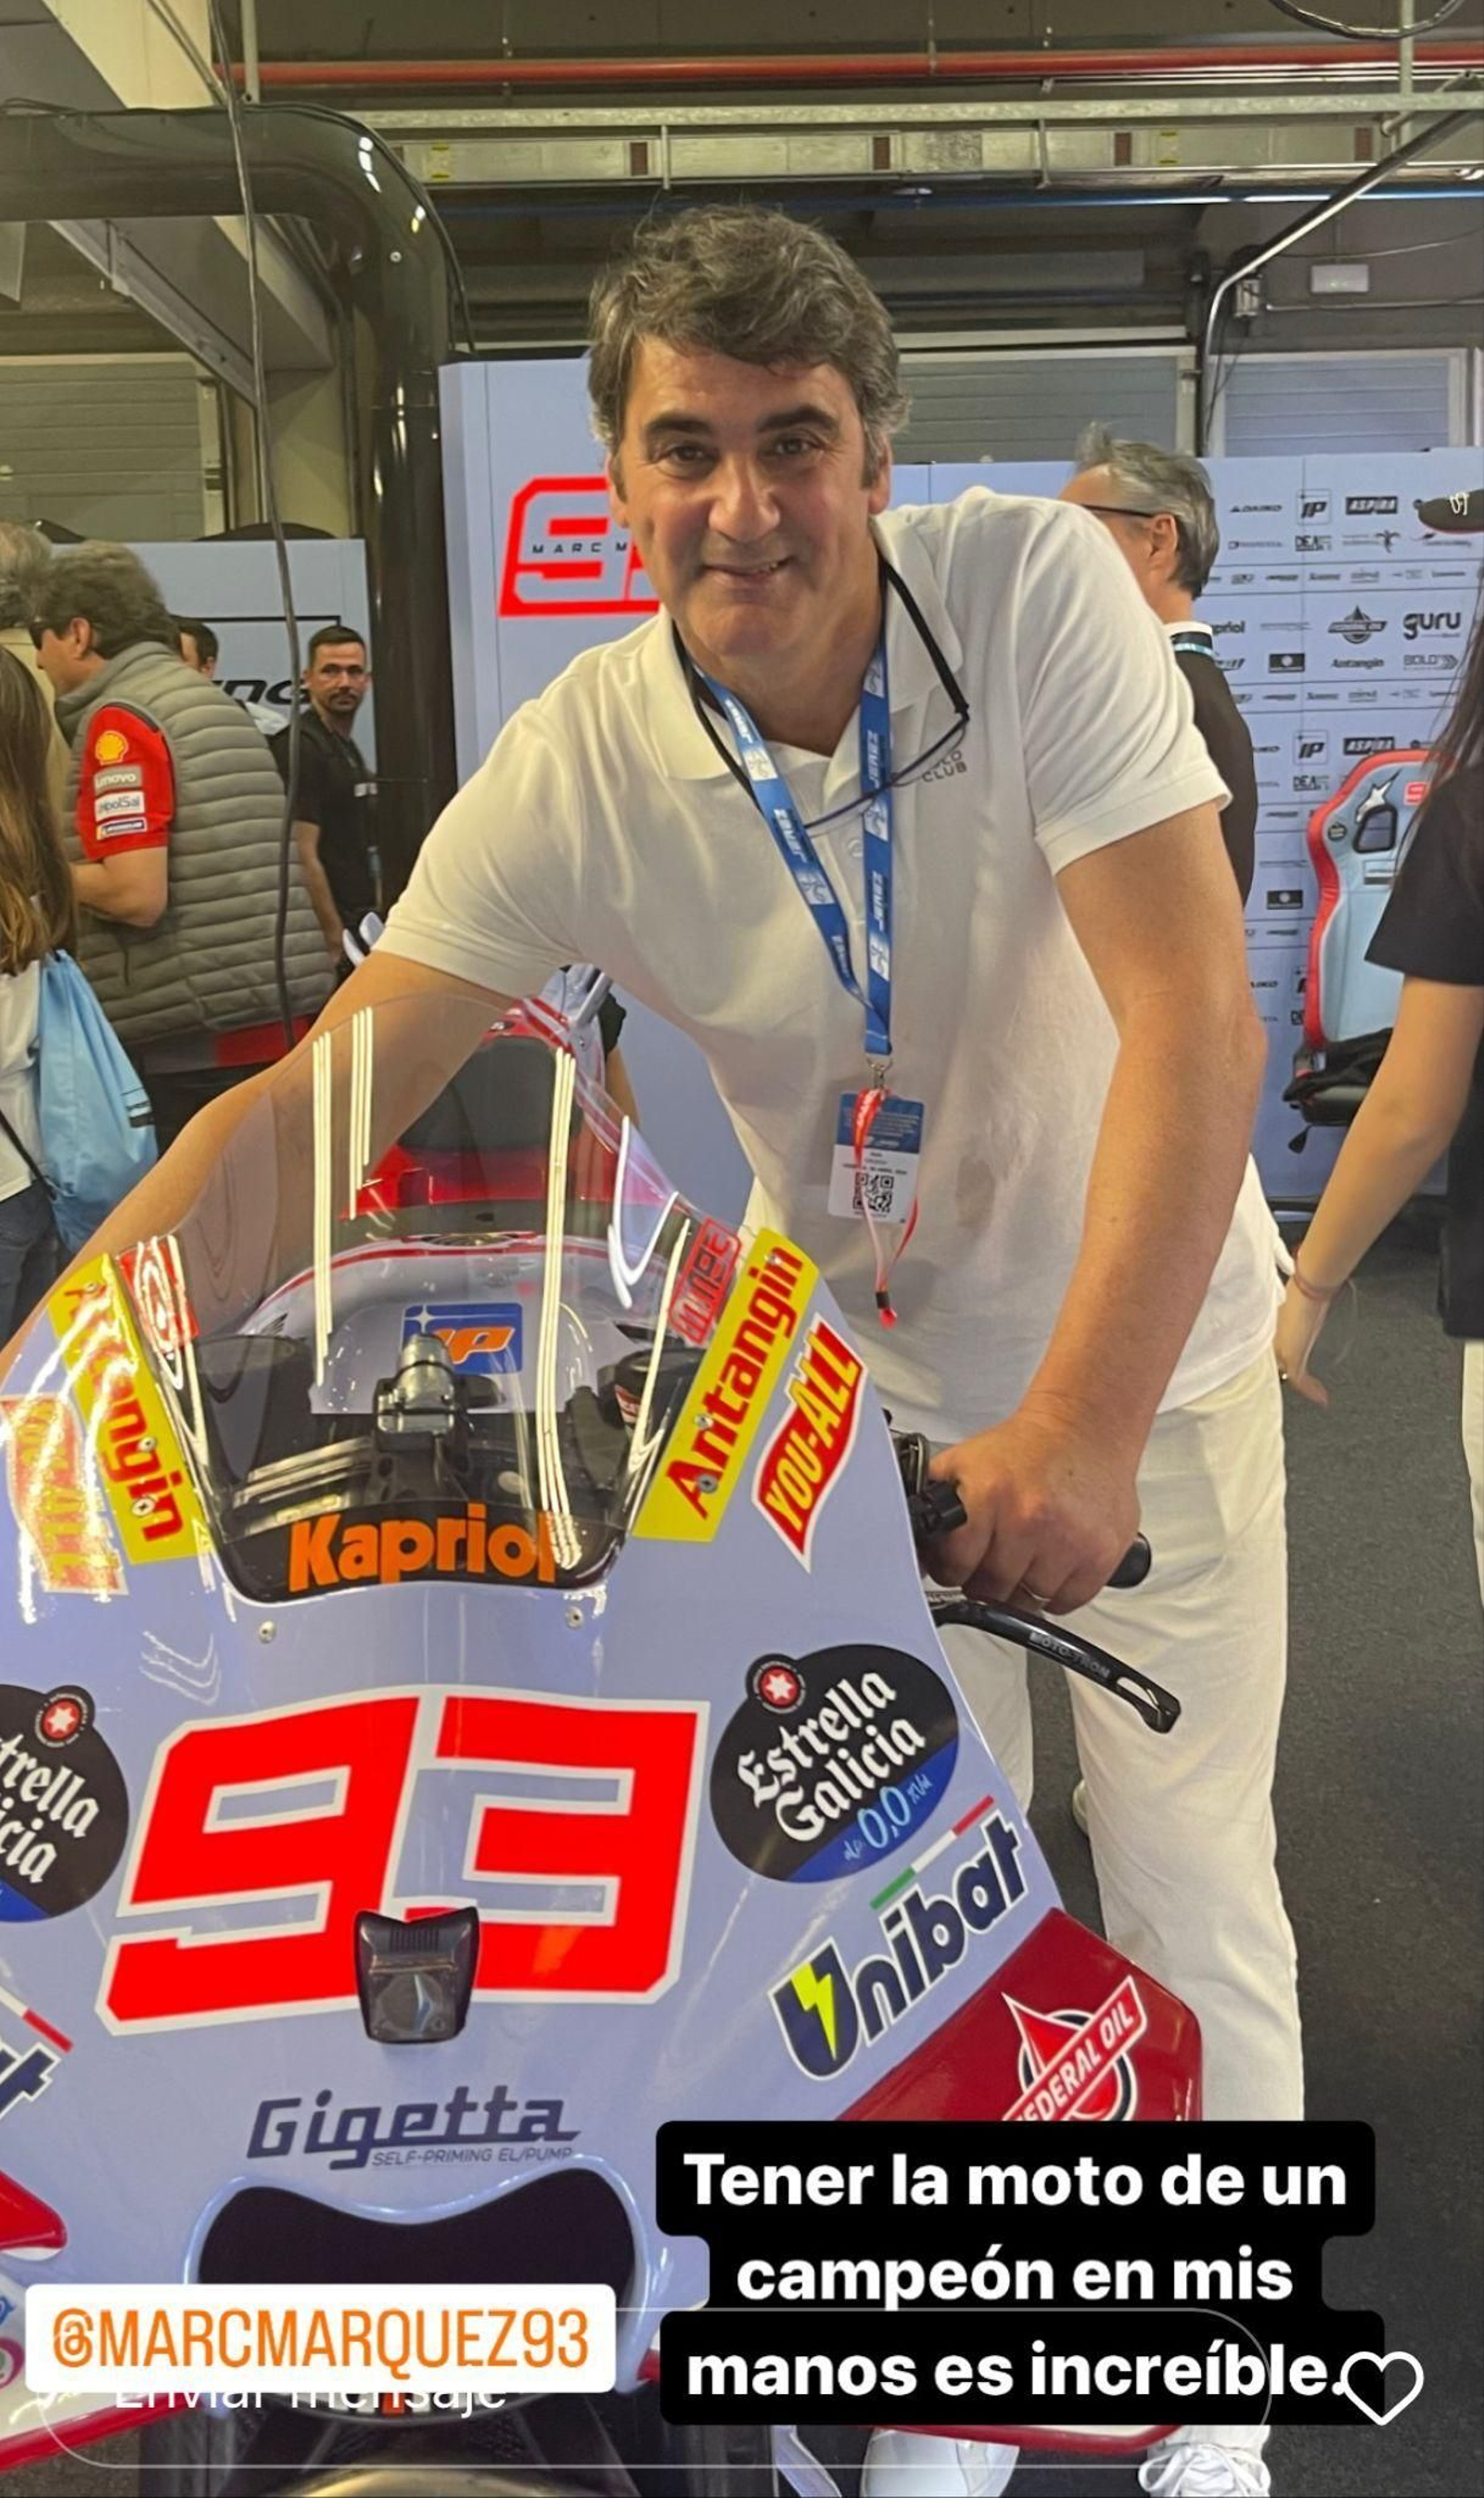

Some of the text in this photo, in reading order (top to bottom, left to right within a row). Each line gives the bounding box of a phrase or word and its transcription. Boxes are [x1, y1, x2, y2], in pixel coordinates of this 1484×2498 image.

[532, 543, 601, 554] MARC
[1211, 621, 1245, 634] priol
[1403, 613, 1461, 640] guru
[922, 762, 967, 783] CLUB
[668, 1245, 803, 1519] Antangin
[765, 1327, 863, 1531] YOU-ALL
[288, 1504, 556, 1594] Kapriol
[738, 1671, 898, 1809] Estrella
[775, 1722, 926, 1844] Galicia
[0, 1734, 99, 1838] trella
[0, 1797, 58, 1883] icia
[98, 1685, 710, 2035] 93
[769, 1811, 1028, 2081] Unibat
[1099, 2001, 1133, 2050] OIL
[1016, 2038, 1102, 2121] EDERAL
[246, 2084, 581, 2171] Gigetta
[372, 2144, 574, 2168] SELF-PRIMING EL/PUMP
